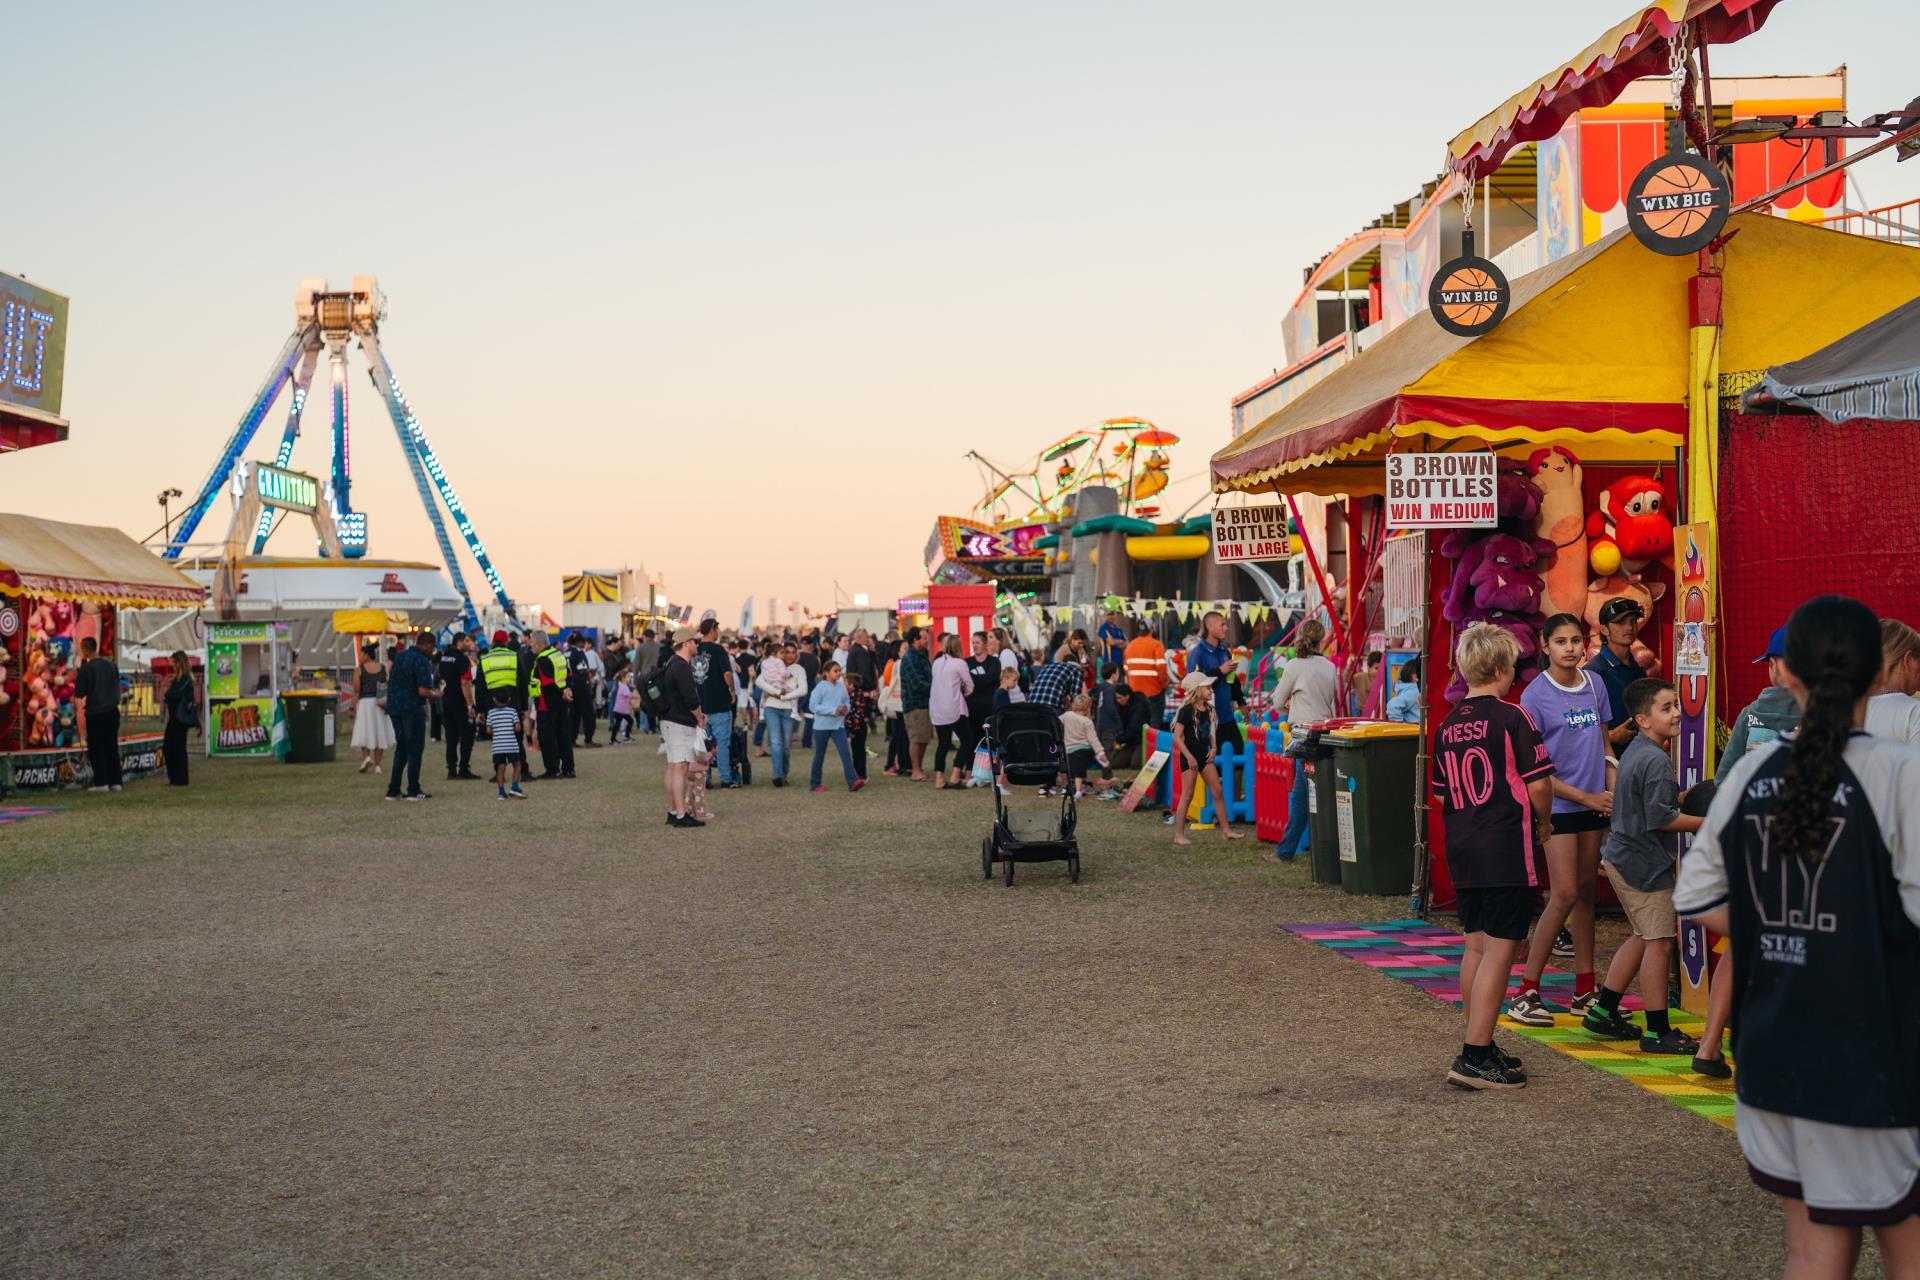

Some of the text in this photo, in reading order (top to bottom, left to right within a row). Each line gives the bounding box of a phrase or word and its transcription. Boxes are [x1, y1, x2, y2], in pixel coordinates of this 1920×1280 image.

[1641, 192, 1712, 211] WIN BIG
[1441, 291, 1498, 303] WIN BIG
[1390, 456, 1493, 476] 3 BROWN
[257, 468, 317, 508] GRAVITRON
[1390, 478, 1494, 498] BOTTLES
[1215, 507, 1285, 524] 4 BROWN
[1390, 502, 1495, 520] WIN MEDIUM
[1216, 523, 1287, 542] BOTTLES
[1217, 541, 1290, 557] WIN LARGE
[1442, 719, 1489, 745] MESSI
[1443, 746, 1495, 810] 10
